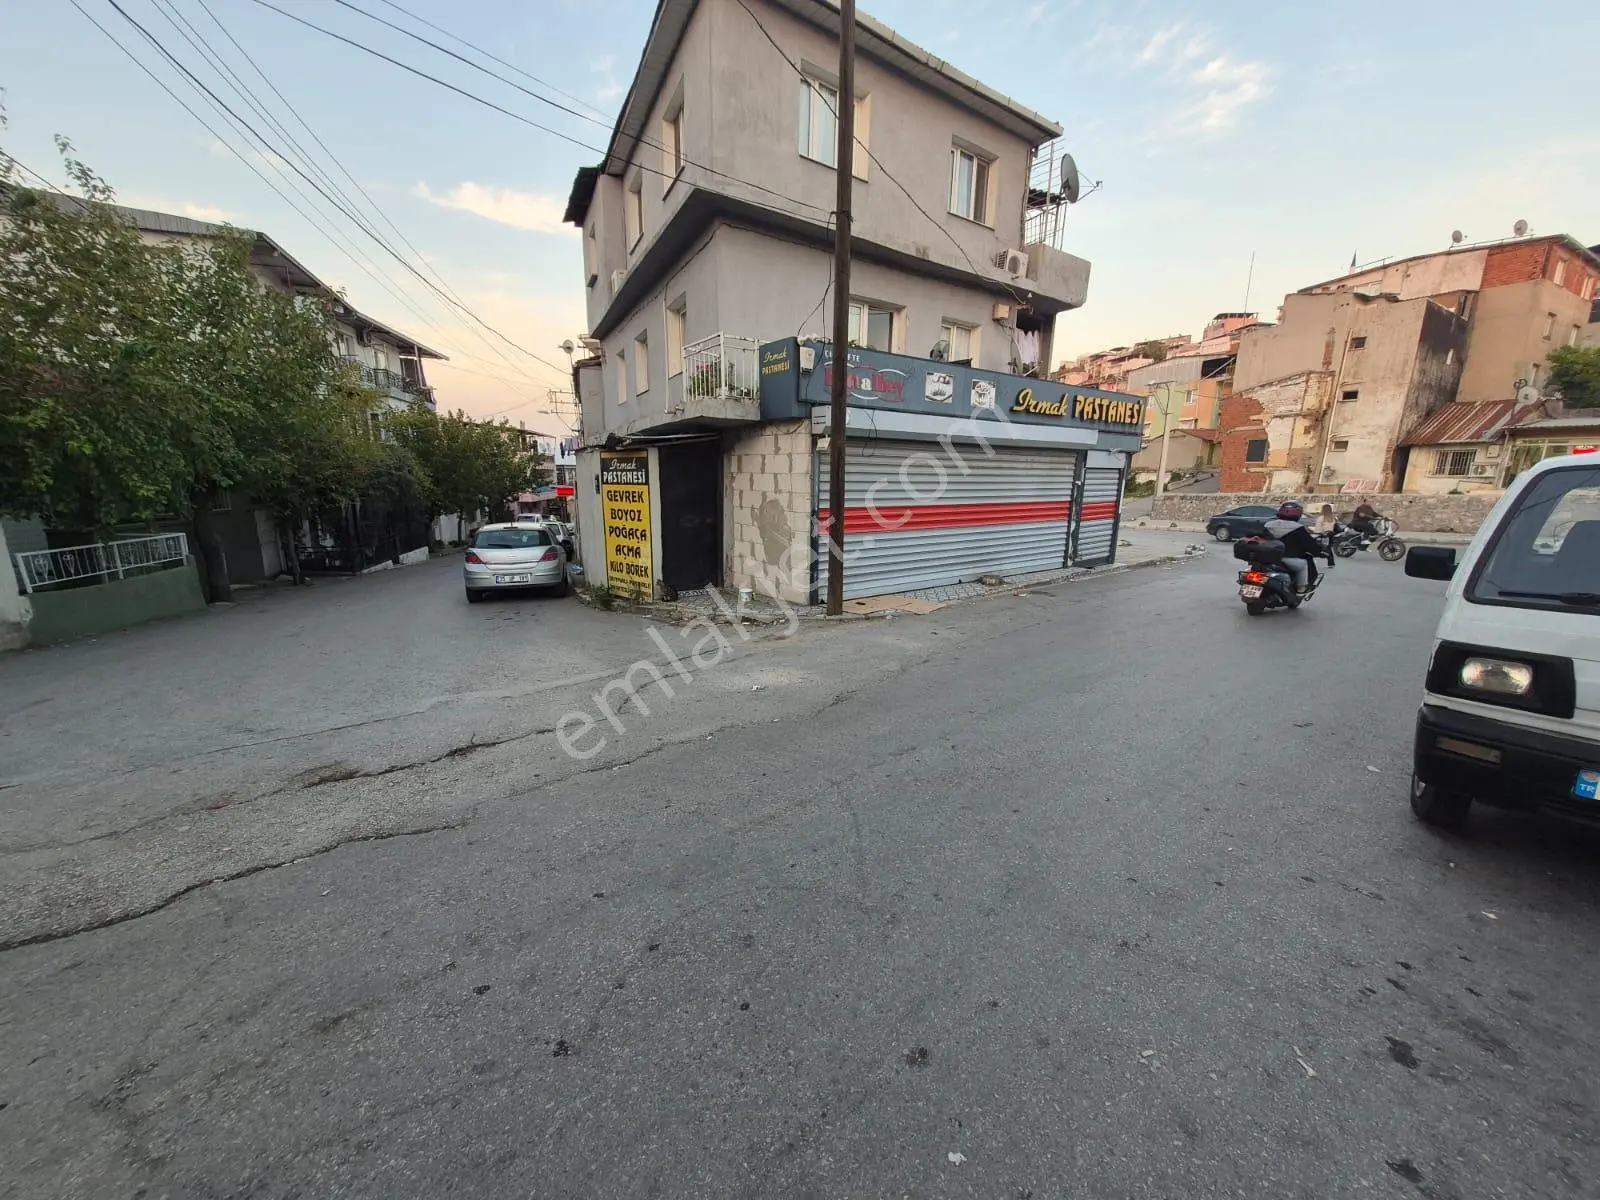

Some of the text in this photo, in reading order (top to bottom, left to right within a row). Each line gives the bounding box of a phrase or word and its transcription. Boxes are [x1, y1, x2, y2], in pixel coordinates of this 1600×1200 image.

[1012, 388, 1068, 416] Irmak
[609, 458, 637, 470] Irmak
[603, 469, 646, 484] PASTANESİ
[607, 489, 644, 504] GEVREK
[610, 508, 642, 522] BOYOZ
[608, 524, 647, 544] POĞAÇA
[616, 544, 641, 559] AÇMA
[625, 561, 649, 578] BÖREK
[1580, 783, 1596, 793] TR
